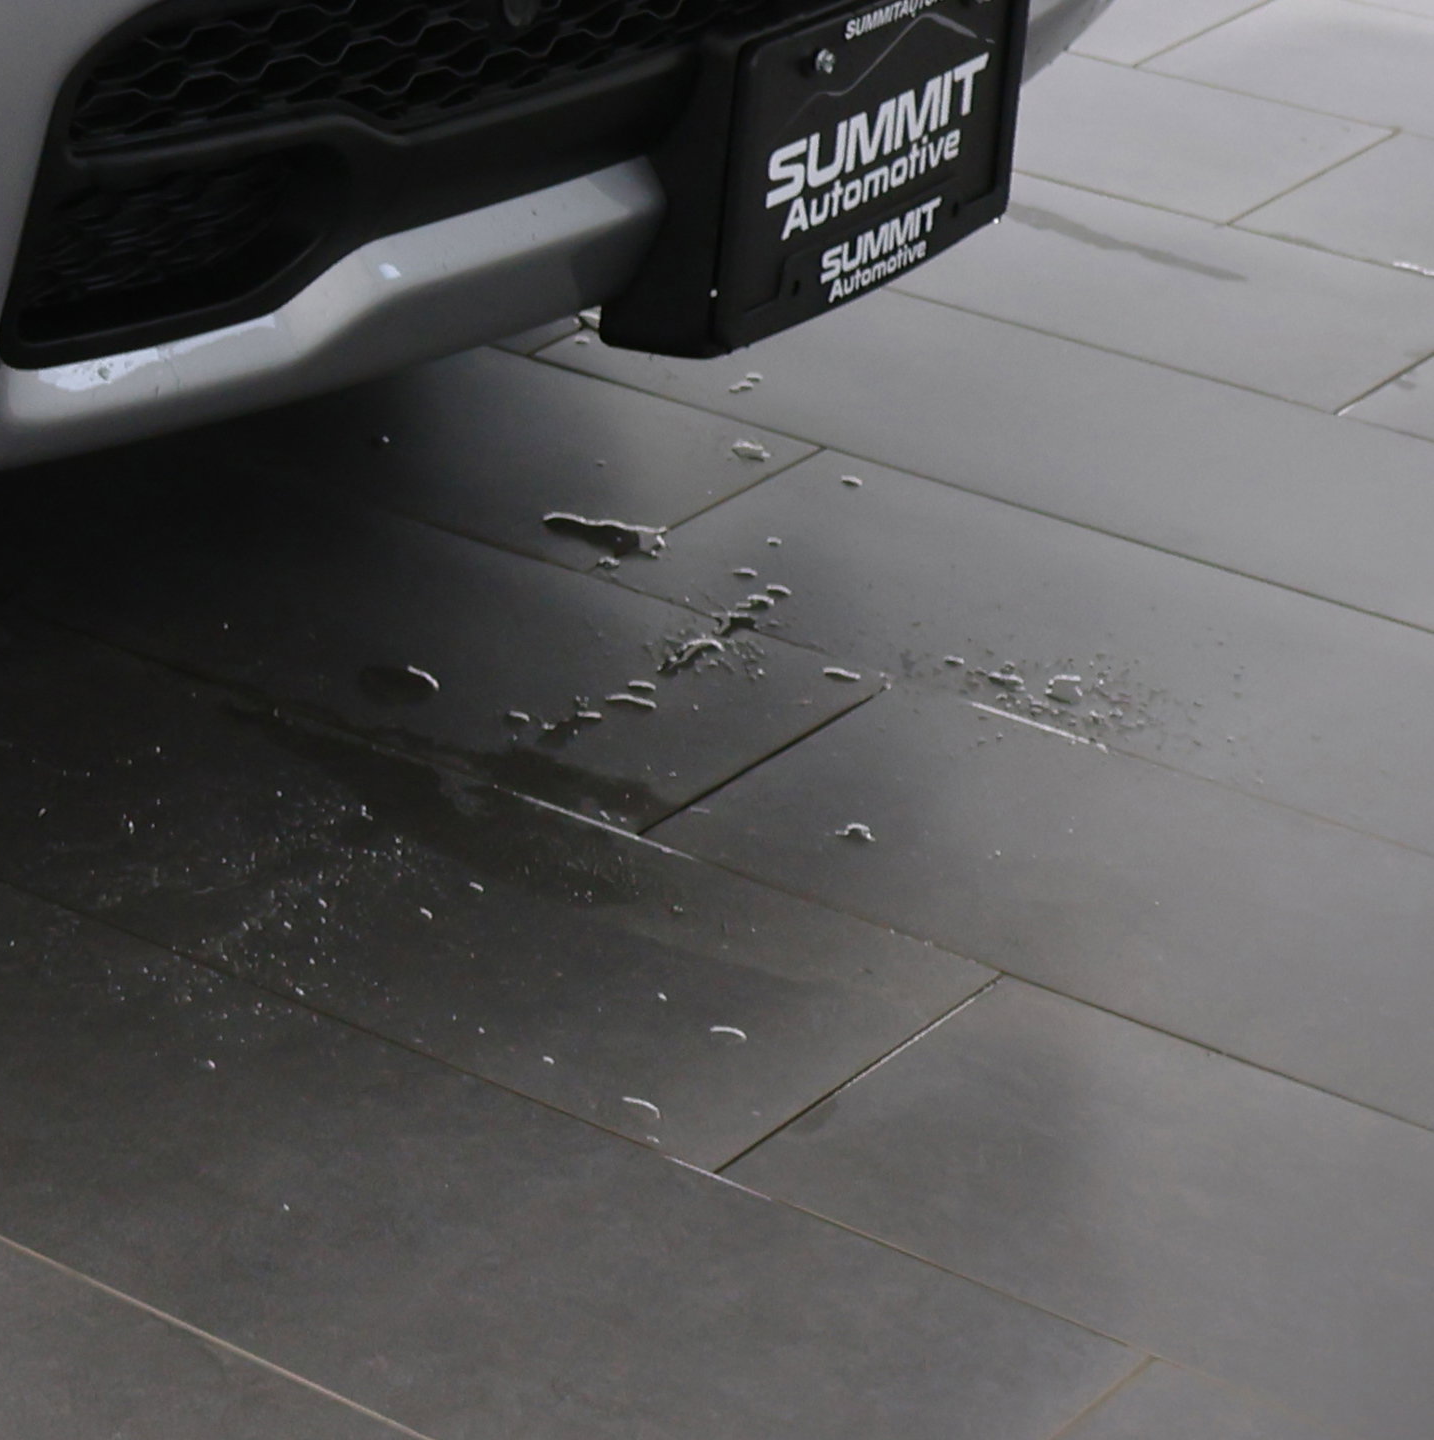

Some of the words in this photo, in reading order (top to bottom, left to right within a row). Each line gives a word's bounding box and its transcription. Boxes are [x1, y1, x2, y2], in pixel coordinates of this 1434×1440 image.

[766, 53, 989, 209] SUMMIT
[781, 128, 961, 241] Automotive
[820, 197, 942, 285] SUMMIT
[828, 239, 927, 303] Automotive
